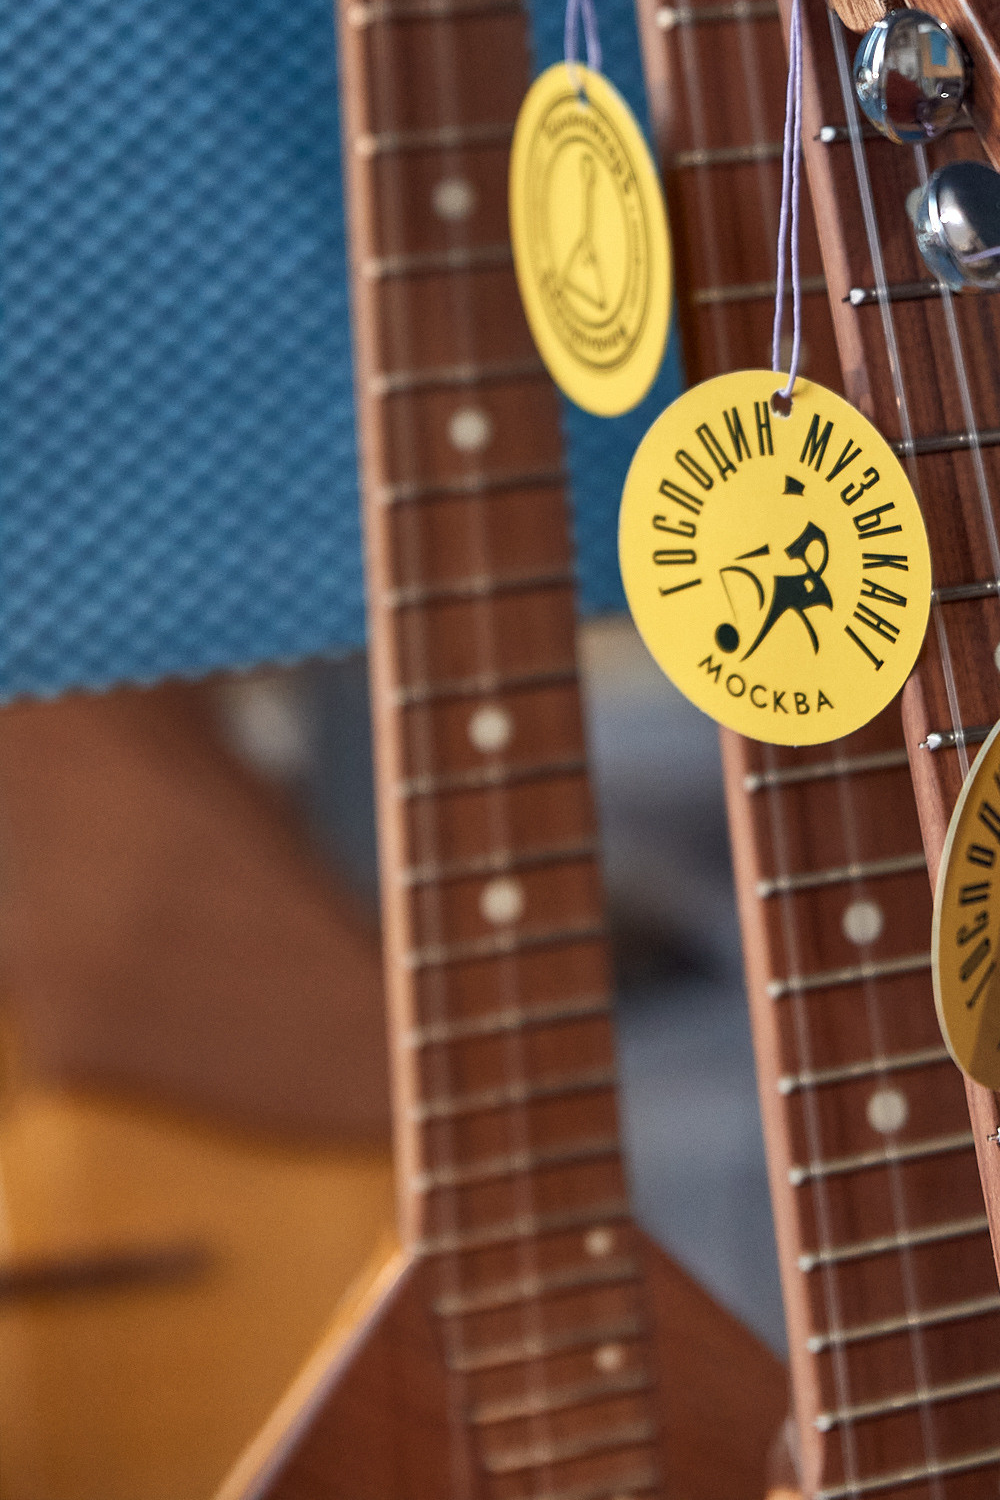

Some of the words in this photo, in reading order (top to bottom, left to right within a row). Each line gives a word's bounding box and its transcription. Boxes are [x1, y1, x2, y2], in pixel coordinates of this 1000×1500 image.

[652, 400, 775, 597] ГОСПОДИН
[799, 412, 909, 672] МУЗЫКАНТ
[698, 653, 835, 716] МОСКВА
